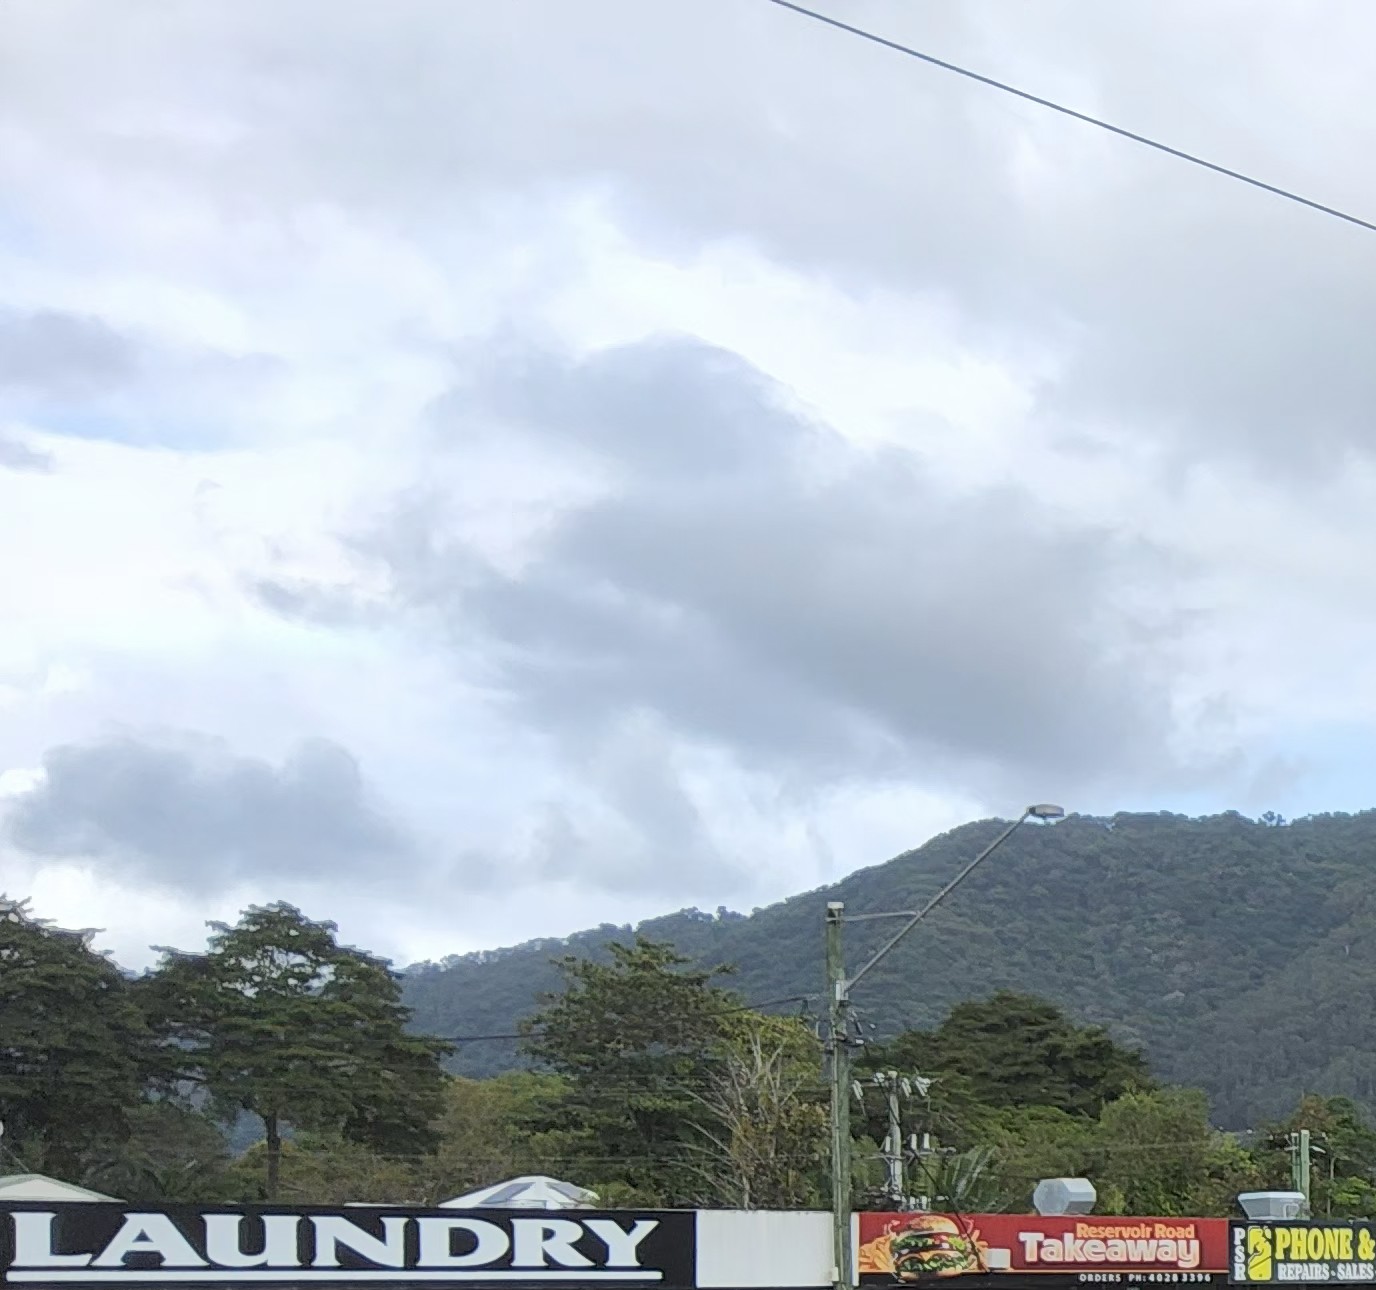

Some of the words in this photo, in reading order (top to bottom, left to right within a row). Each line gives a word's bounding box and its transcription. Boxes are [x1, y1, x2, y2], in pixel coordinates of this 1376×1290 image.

[8, 1210, 660, 1269] LAUNDRY
[1076, 1222, 1152, 1239] Reservoir
[1153, 1223, 1196, 1239] Road
[1275, 1228, 1353, 1260] PHONE
[1359, 1228, 1376, 1261] &
[1018, 1231, 1201, 1268] Takeaway
[1233, 1227, 1246, 1281] PSR
[1078, 1273, 1122, 1283] ORDERS
[1277, 1262, 1330, 1280] REPAIRS
[1337, 1262, 1374, 1280] SALES
